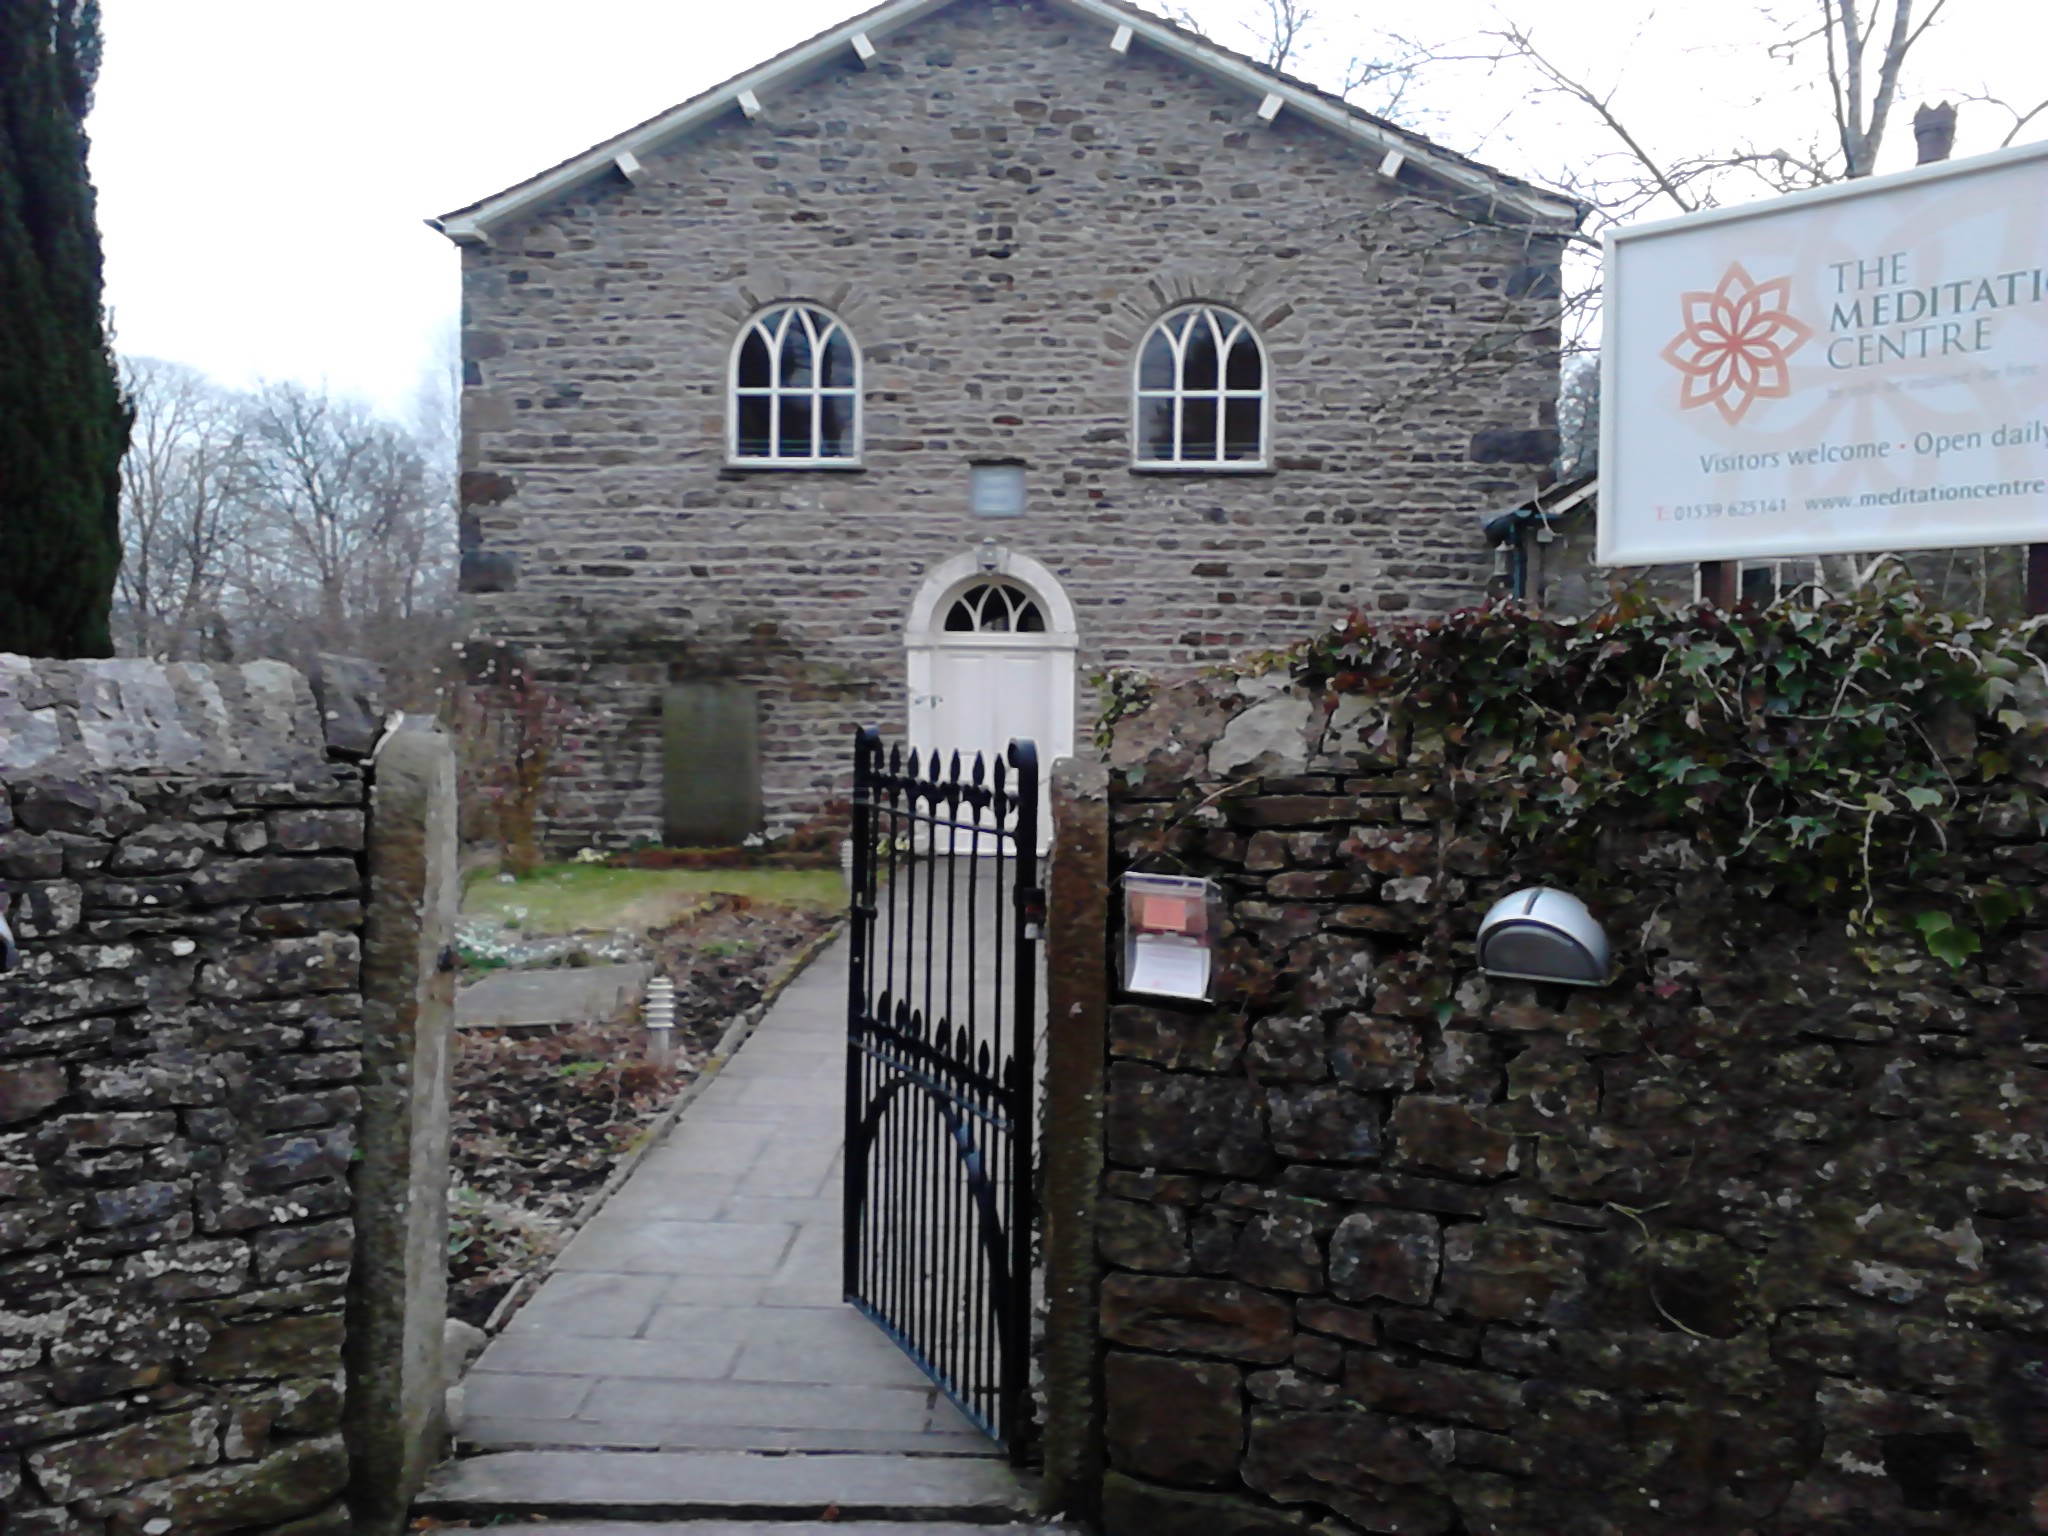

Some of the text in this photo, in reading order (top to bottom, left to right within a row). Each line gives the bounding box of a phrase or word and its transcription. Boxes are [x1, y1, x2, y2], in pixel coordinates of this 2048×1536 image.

[1829, 252, 1908, 294] THE
[1830, 269, 2048, 332] MEDITATI
[1827, 317, 1992, 370] CENTRE
[1700, 452, 1780, 474] Visitors
[1787, 441, 1891, 467] welcome
[1913, 431, 1982, 459] Open
